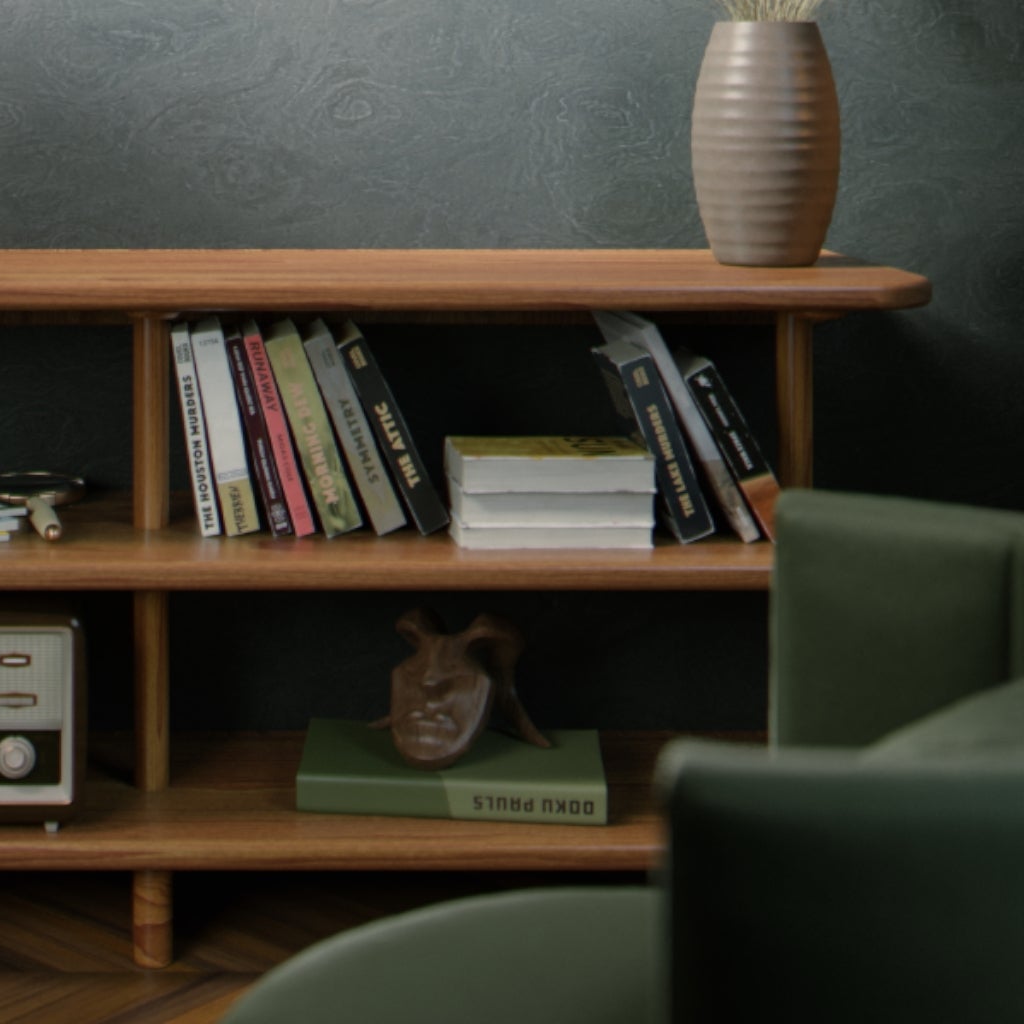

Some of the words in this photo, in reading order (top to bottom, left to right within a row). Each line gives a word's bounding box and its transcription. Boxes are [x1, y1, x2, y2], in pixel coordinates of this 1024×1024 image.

[249, 342, 278, 412] RUNAWAY
[286, 382, 311, 421] DEW
[181, 375, 201, 436] MURDERS
[373, 401, 406, 452] ATTIC
[302, 419, 339, 505] MORNING
[339, 398, 379, 484] SYMMETRY
[191, 439, 212, 502] HOUSTON
[397, 451, 421, 489] THE
[201, 505, 214, 530] THE
[473, 795, 535, 812] PAULS
[542, 798, 594, 815] DOKU
